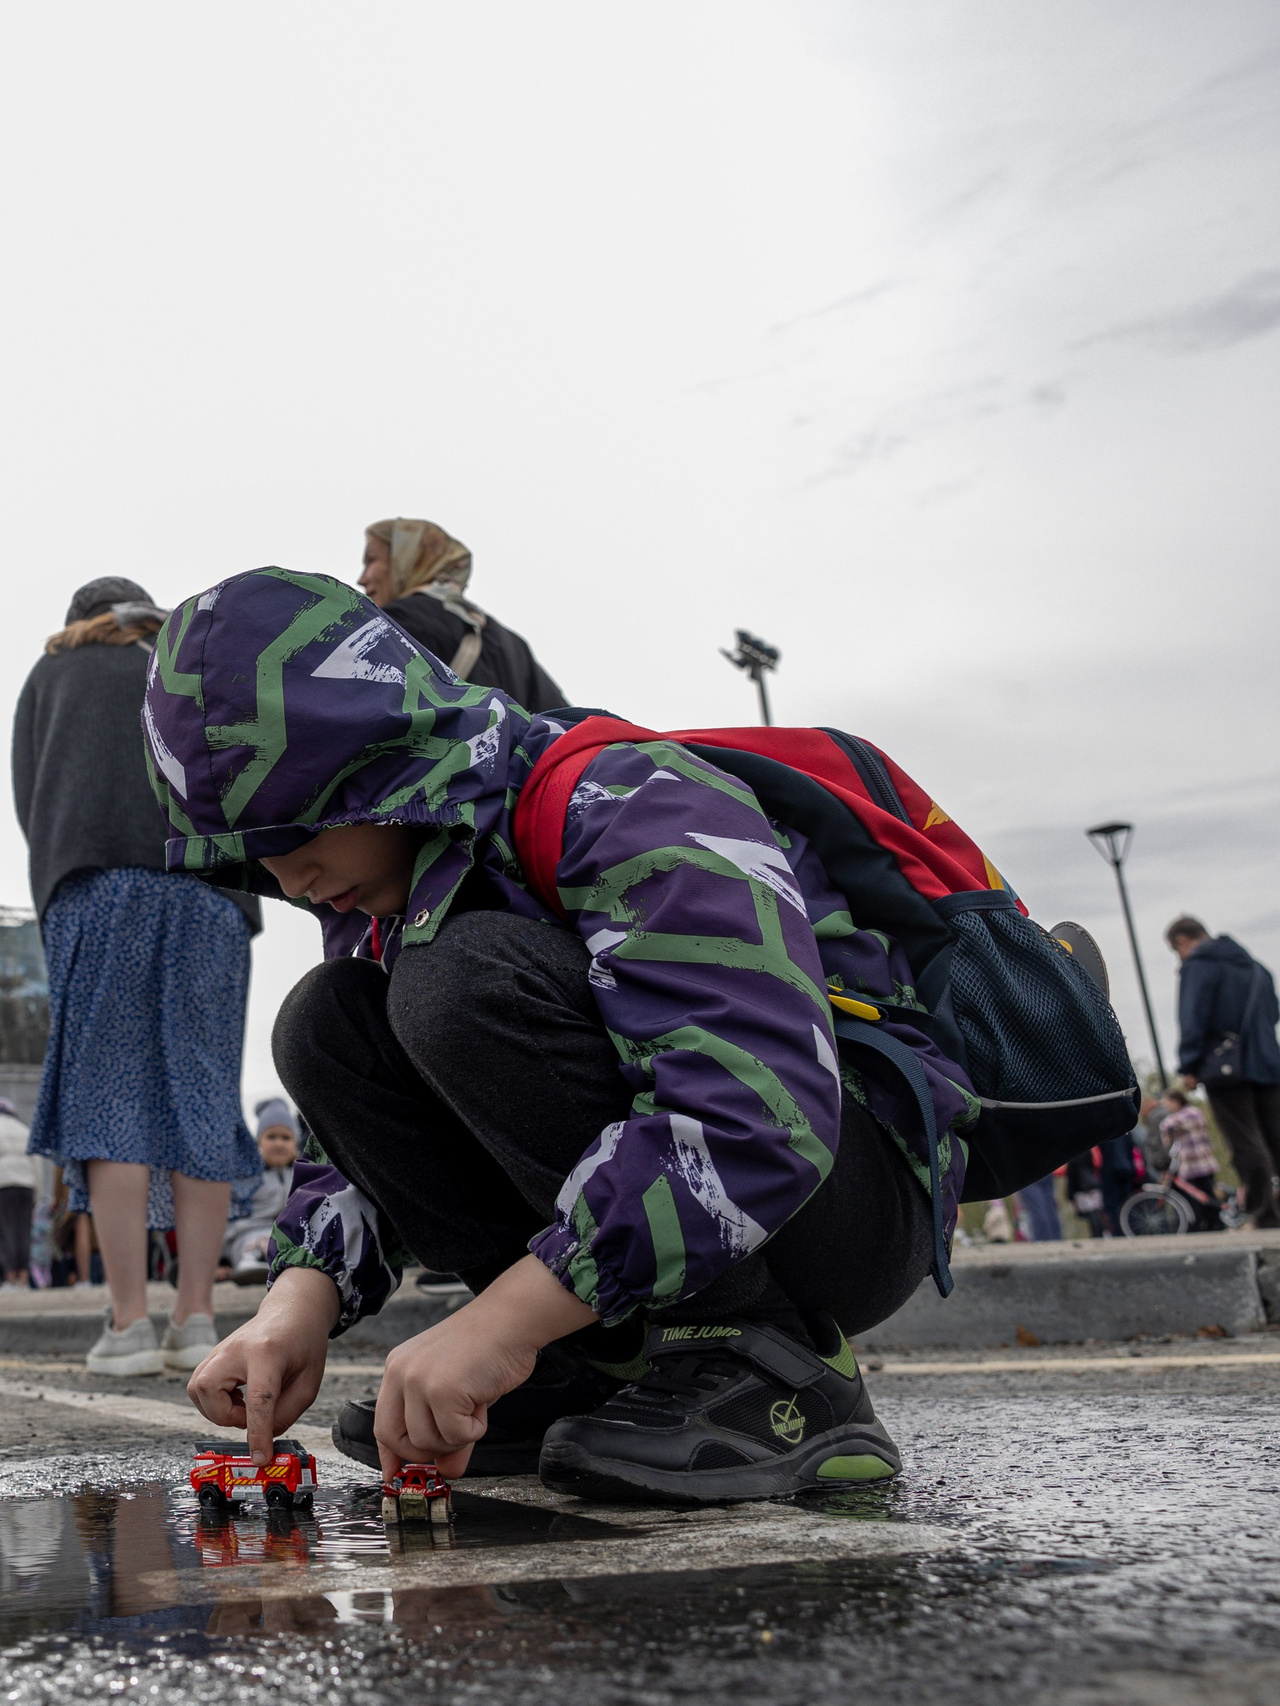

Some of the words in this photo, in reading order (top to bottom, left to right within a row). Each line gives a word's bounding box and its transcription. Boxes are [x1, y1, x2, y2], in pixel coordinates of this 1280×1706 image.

[661, 1326, 697, 1342] TIME
[693, 1326, 742, 1338] JUMP
[771, 1423, 787, 1435] TIME
[787, 1416, 806, 1431] JUMP
